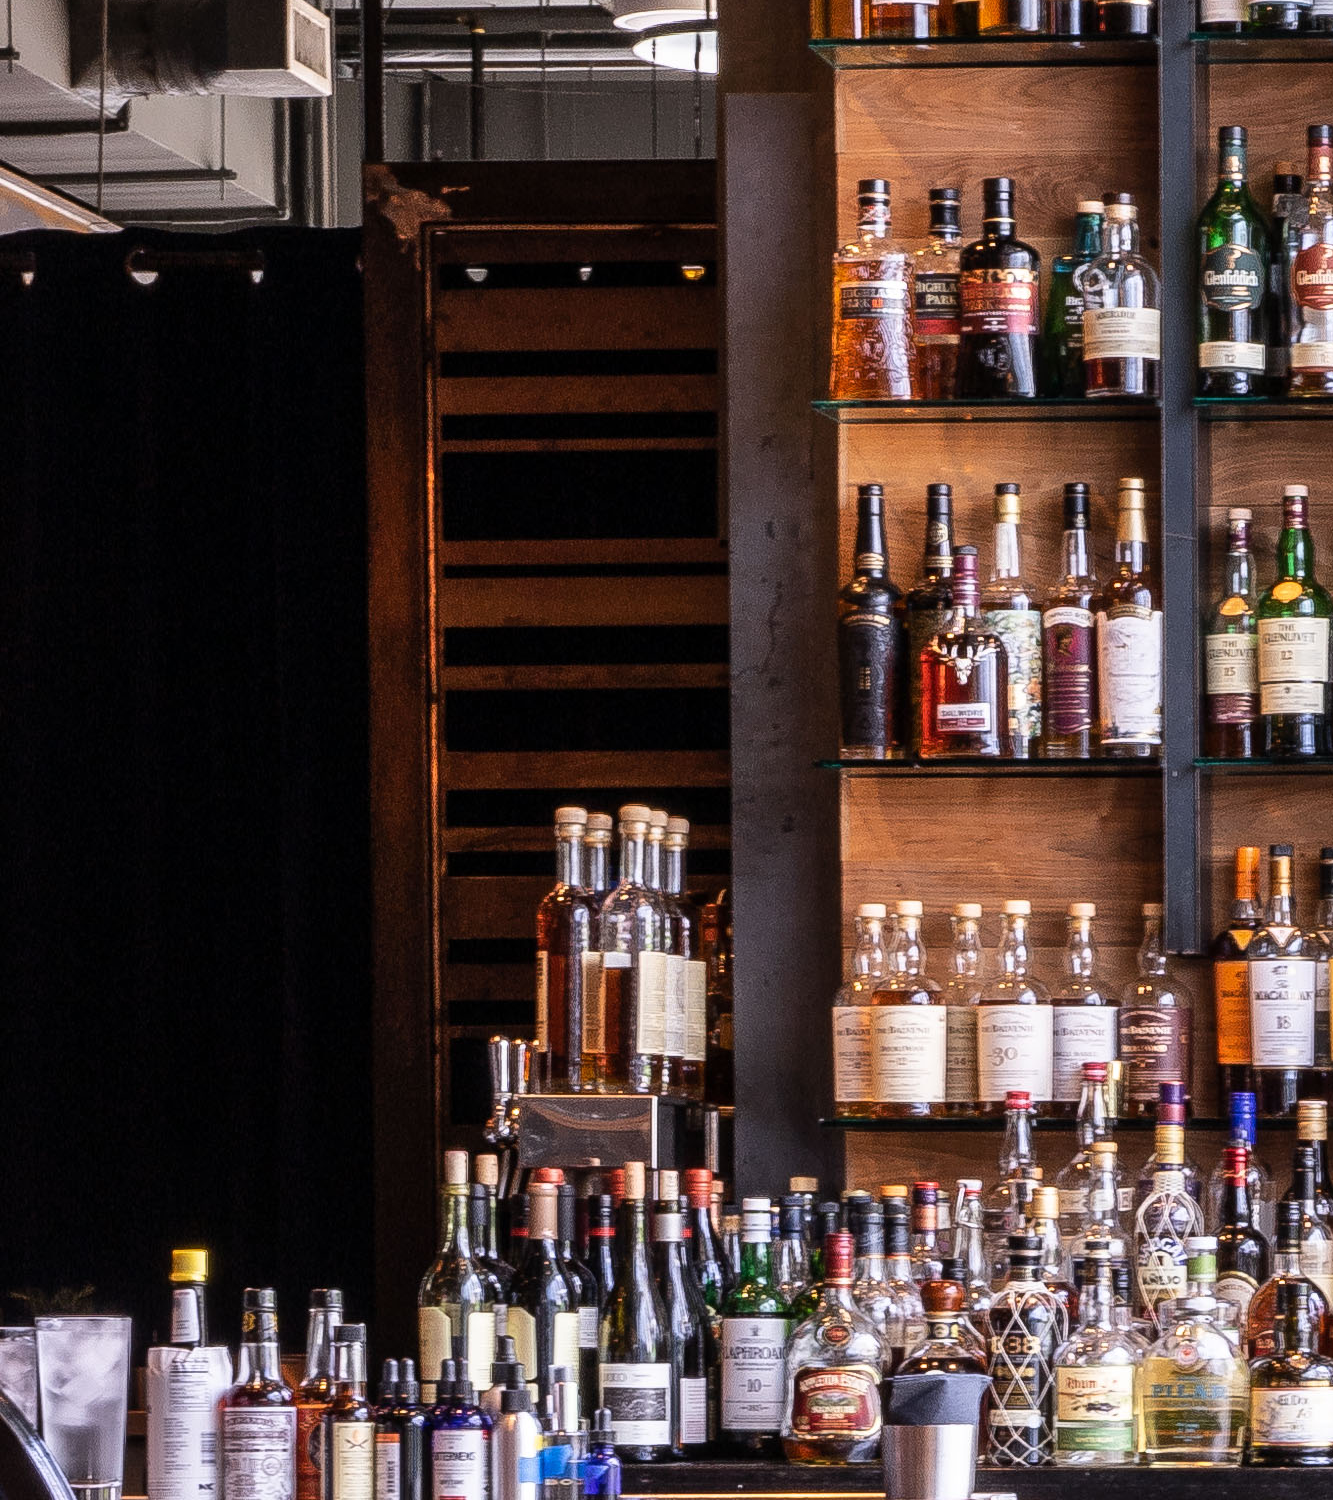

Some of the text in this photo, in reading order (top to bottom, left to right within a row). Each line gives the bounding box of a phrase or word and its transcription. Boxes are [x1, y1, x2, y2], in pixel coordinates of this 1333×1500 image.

[991, 1046, 1018, 1067] 30
[746, 1378, 762, 1393] 10
[1151, 1383, 1227, 1400] PILAR
